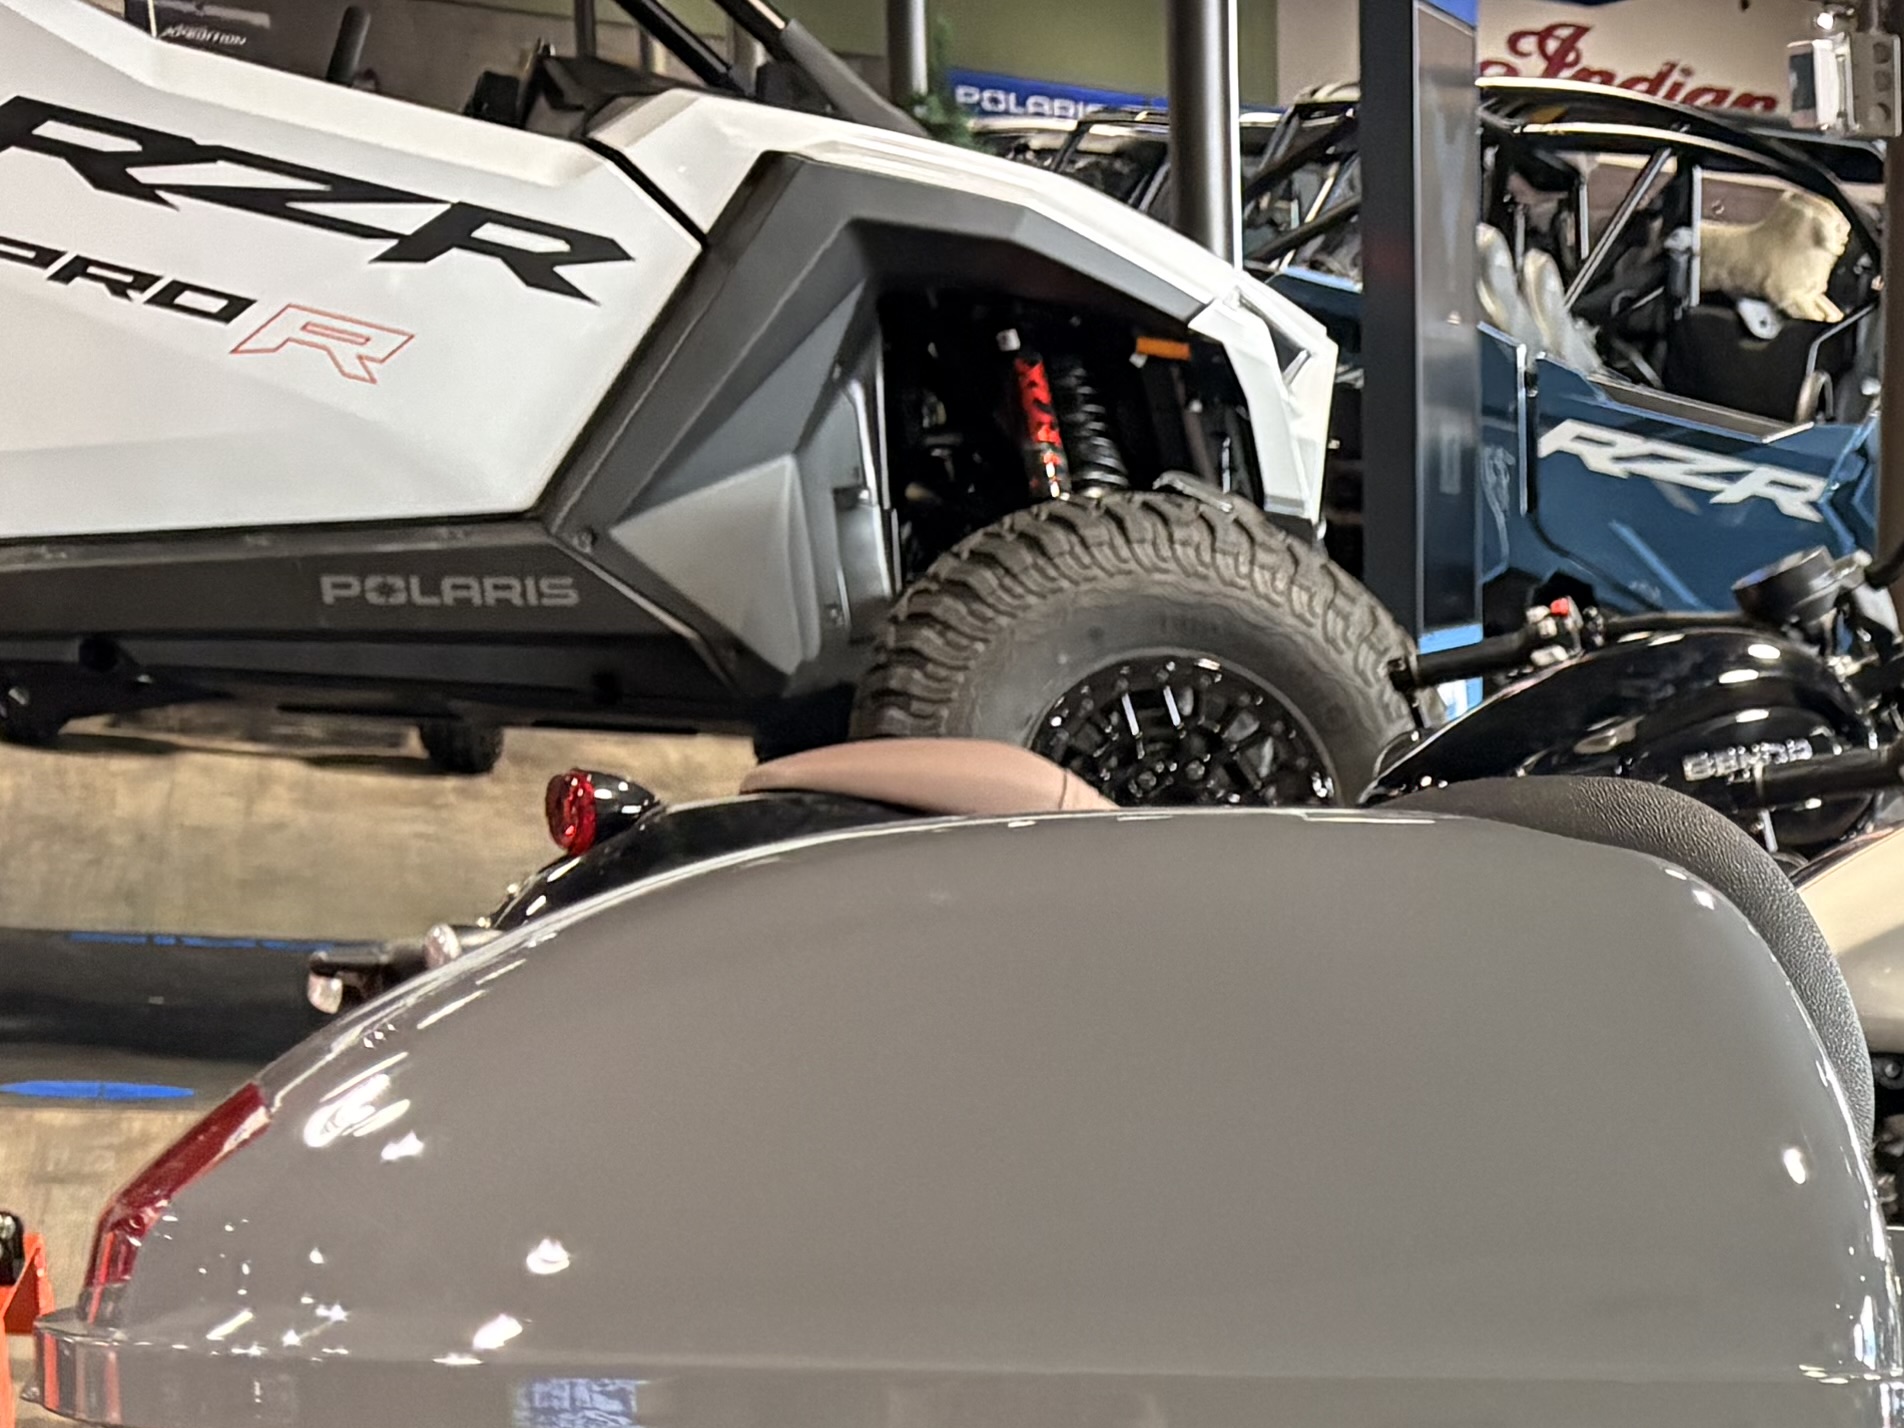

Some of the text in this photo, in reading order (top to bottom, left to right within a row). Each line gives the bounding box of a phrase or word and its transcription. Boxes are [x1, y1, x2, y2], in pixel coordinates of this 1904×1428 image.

[0, 94, 634, 304] RZR
[229, 303, 416, 384] R
[1538, 418, 1828, 523] RZR
[321, 573, 579, 609] POLARIS
